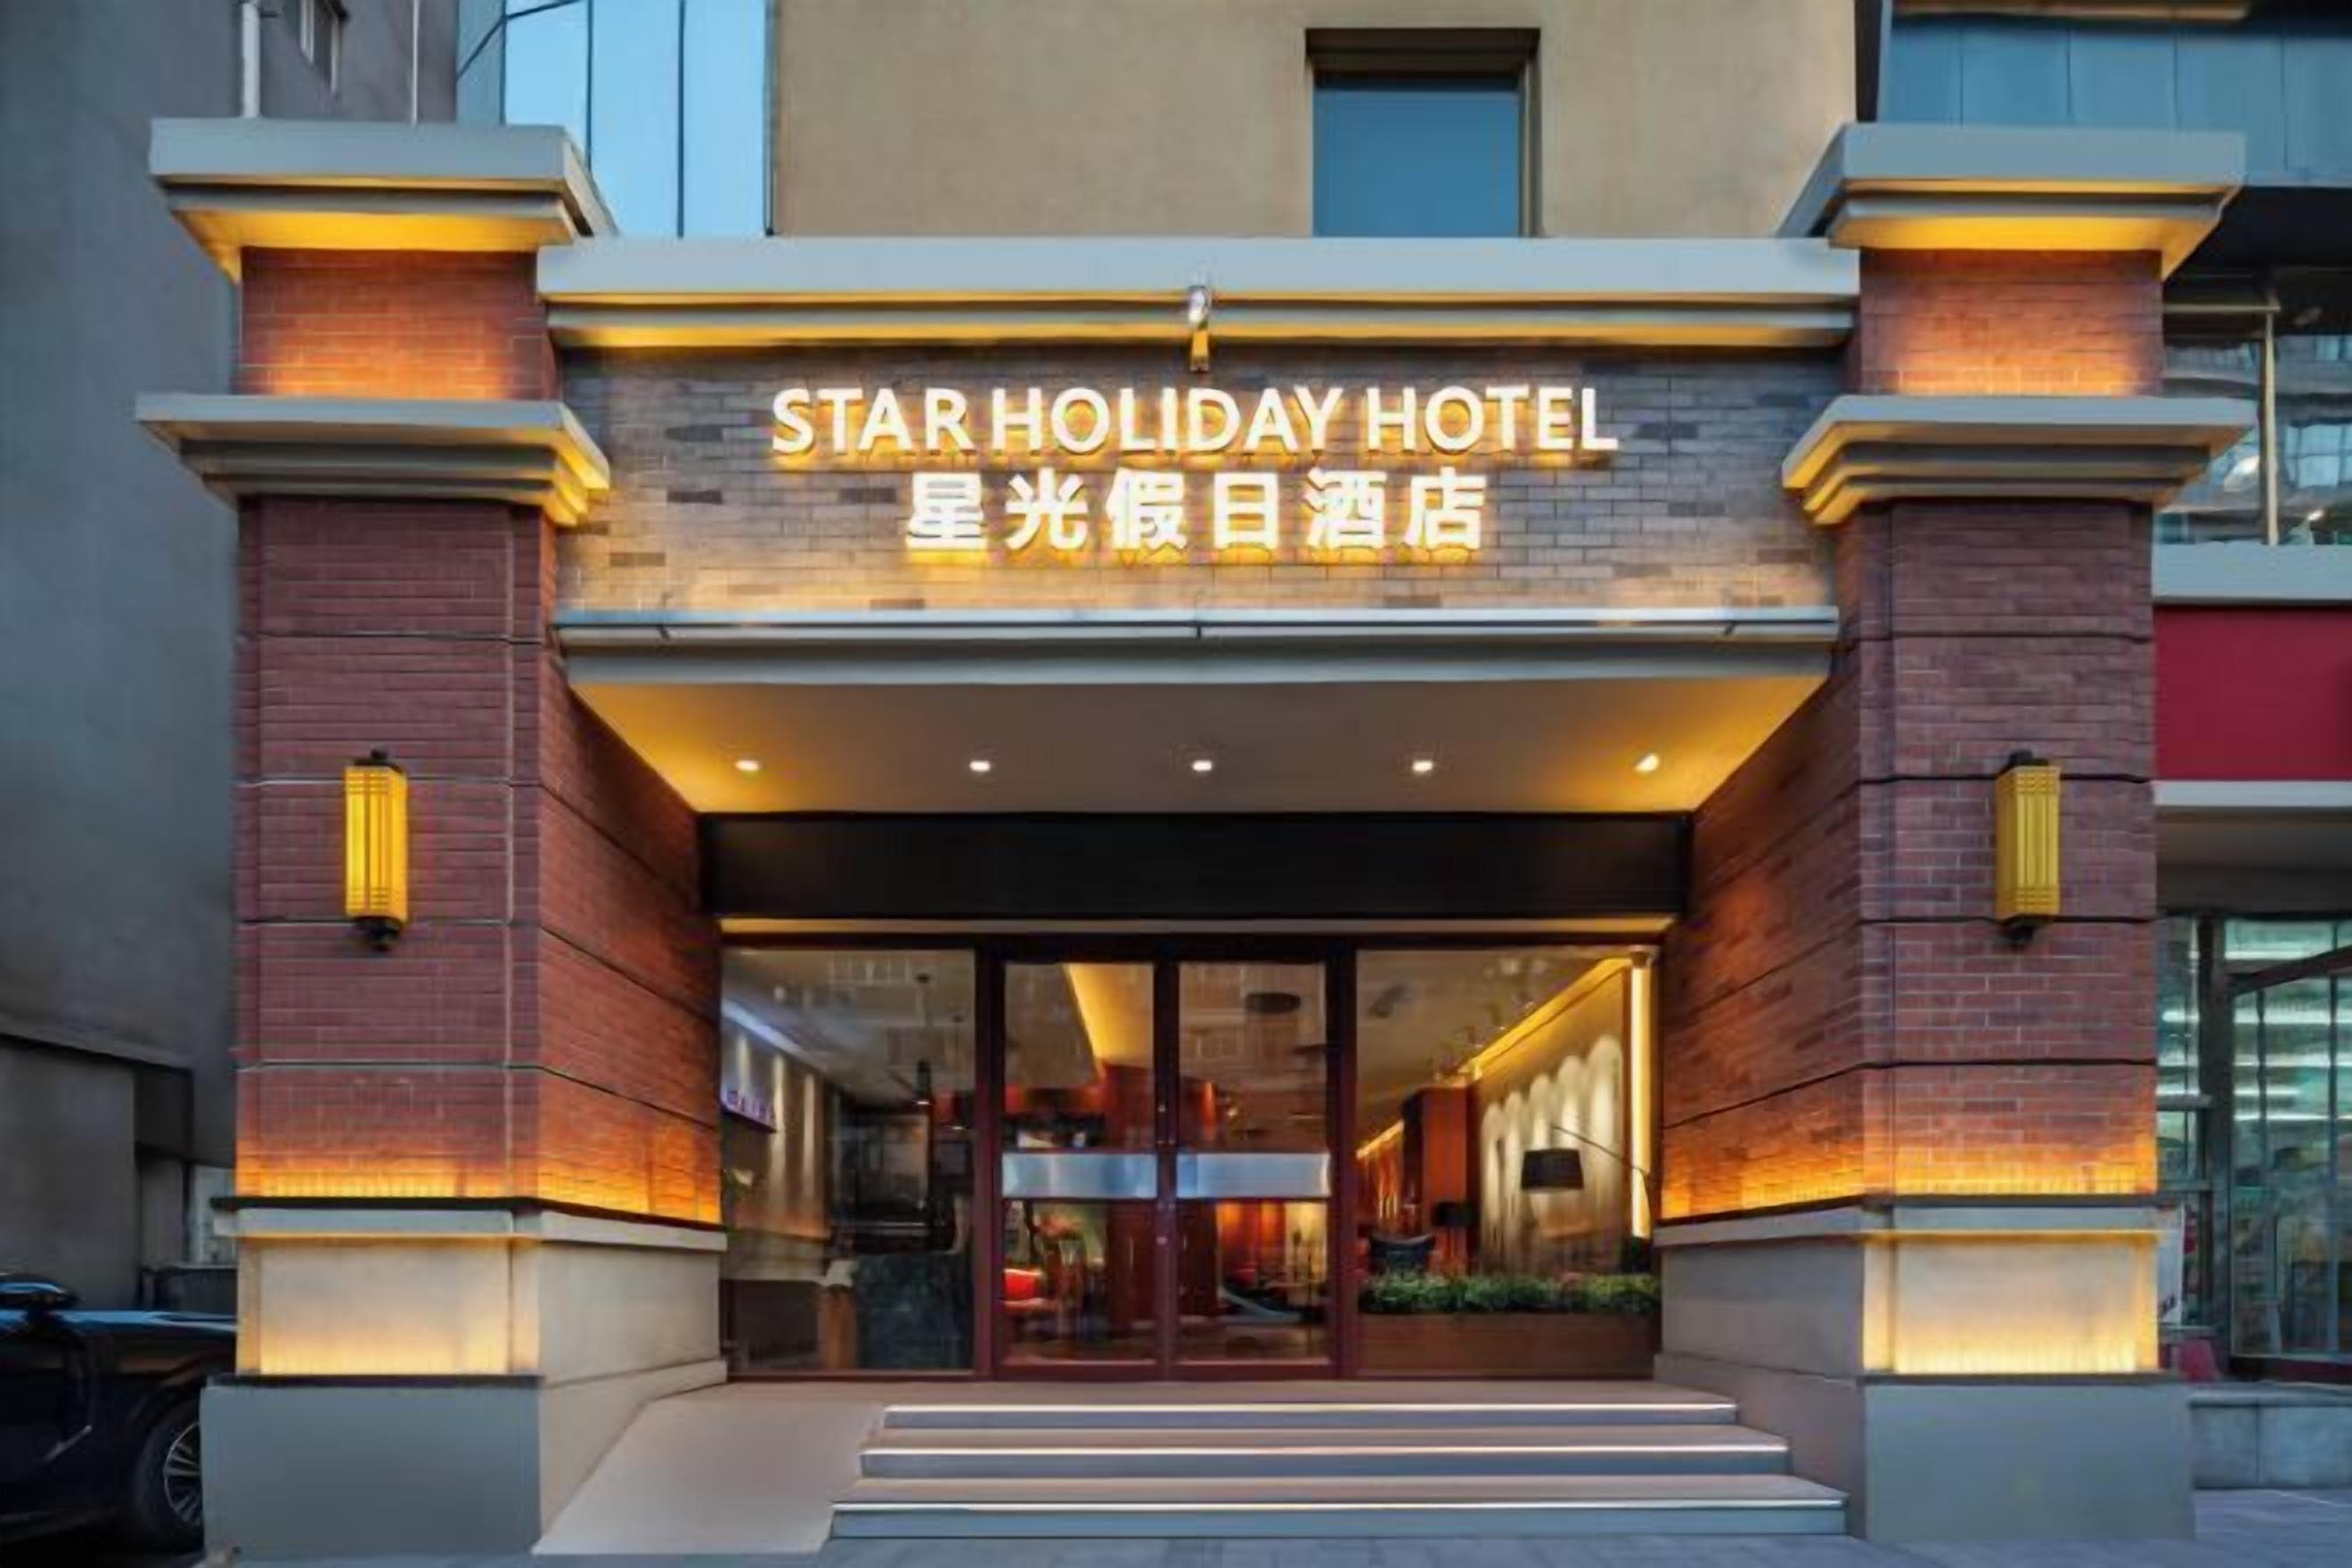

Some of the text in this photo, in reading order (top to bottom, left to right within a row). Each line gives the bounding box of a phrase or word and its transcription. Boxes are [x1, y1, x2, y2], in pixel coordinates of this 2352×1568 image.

[771, 385, 1620, 454] STAR HOLIDAY HOTEL
[904, 466, 1488, 551] 星光假日酒店
